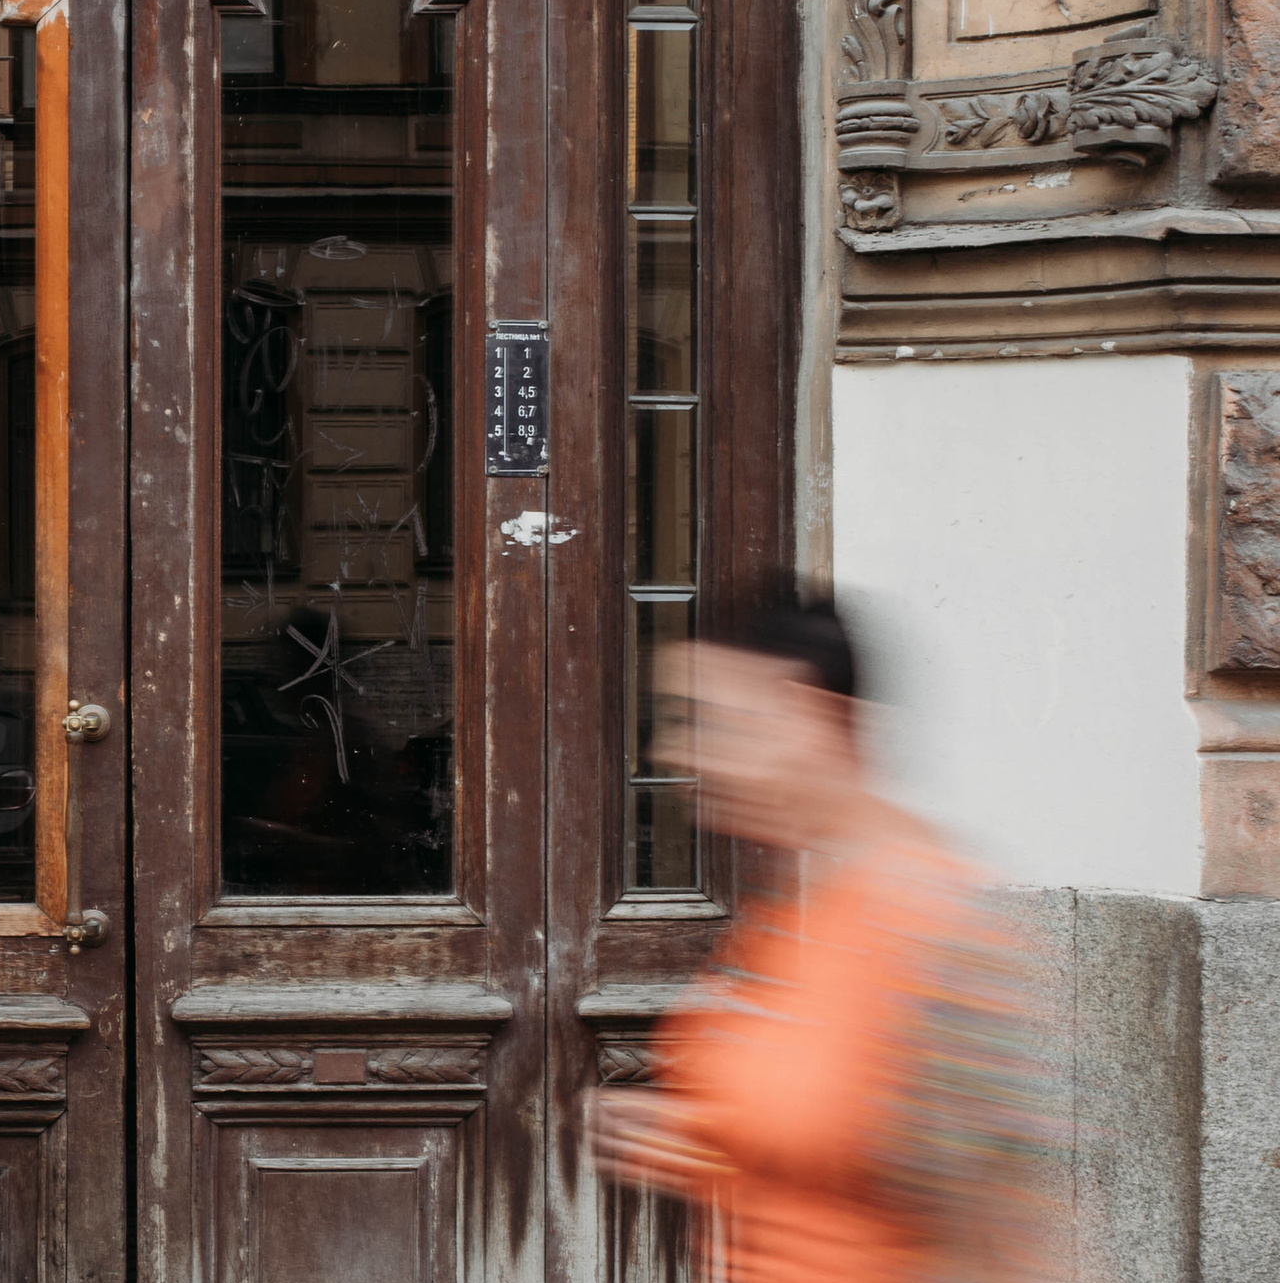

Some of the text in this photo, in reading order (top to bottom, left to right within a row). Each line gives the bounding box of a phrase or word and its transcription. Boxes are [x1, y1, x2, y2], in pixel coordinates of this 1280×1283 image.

[496, 332, 529, 341] ЛЕСТНИЦА
[494, 346, 531, 359] 1 1
[494, 366, 531, 378] 2 2
[494, 386, 536, 400] 3 4,5
[494, 405, 536, 419] 4 6,7
[494, 425, 536, 439] 5 8,9
